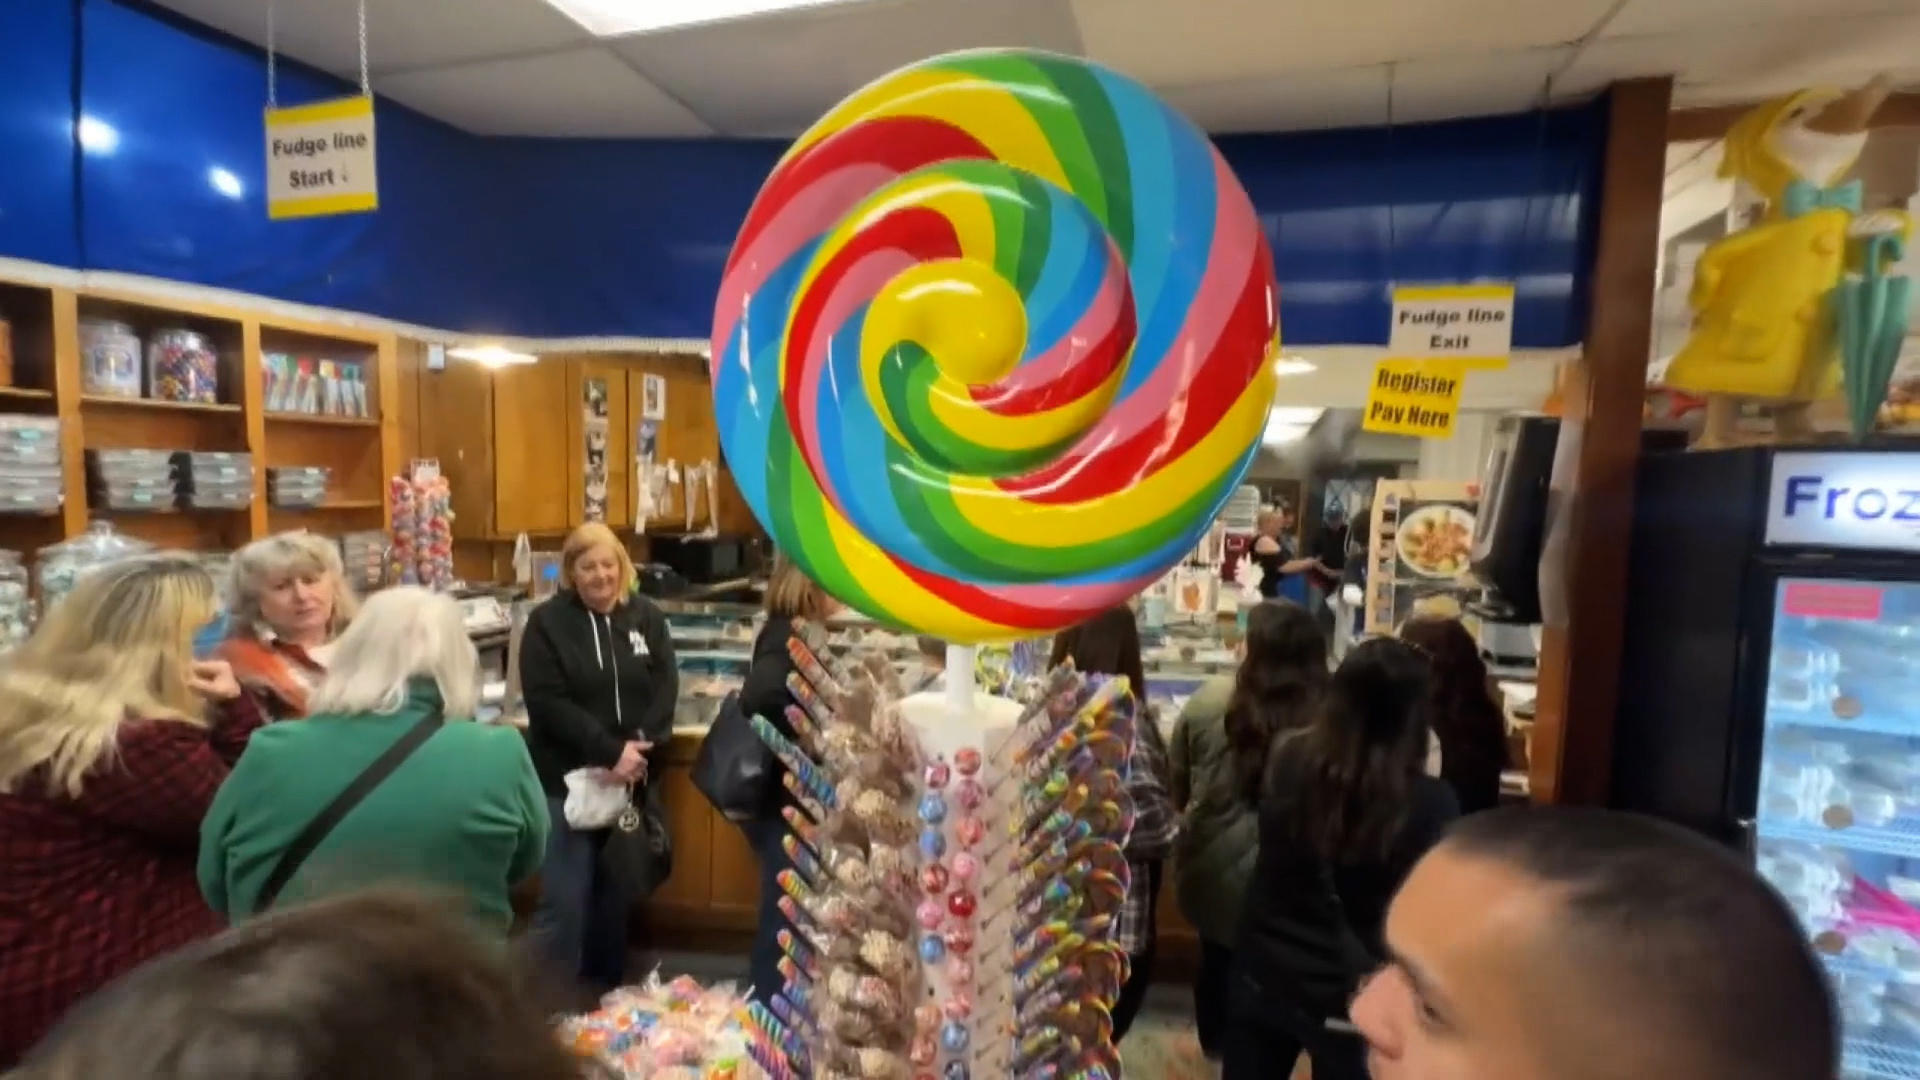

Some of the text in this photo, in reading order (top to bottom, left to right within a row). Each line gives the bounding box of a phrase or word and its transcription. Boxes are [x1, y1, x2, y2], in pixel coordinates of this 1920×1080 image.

[273, 132, 367, 157] Fudge line
[289, 169, 334, 190] Start
[1400, 308, 1506, 328] Fudge line
[1429, 334, 1470, 349] Exit
[1376, 368, 1456, 396] Register
[1370, 400, 1450, 428] Pay Here
